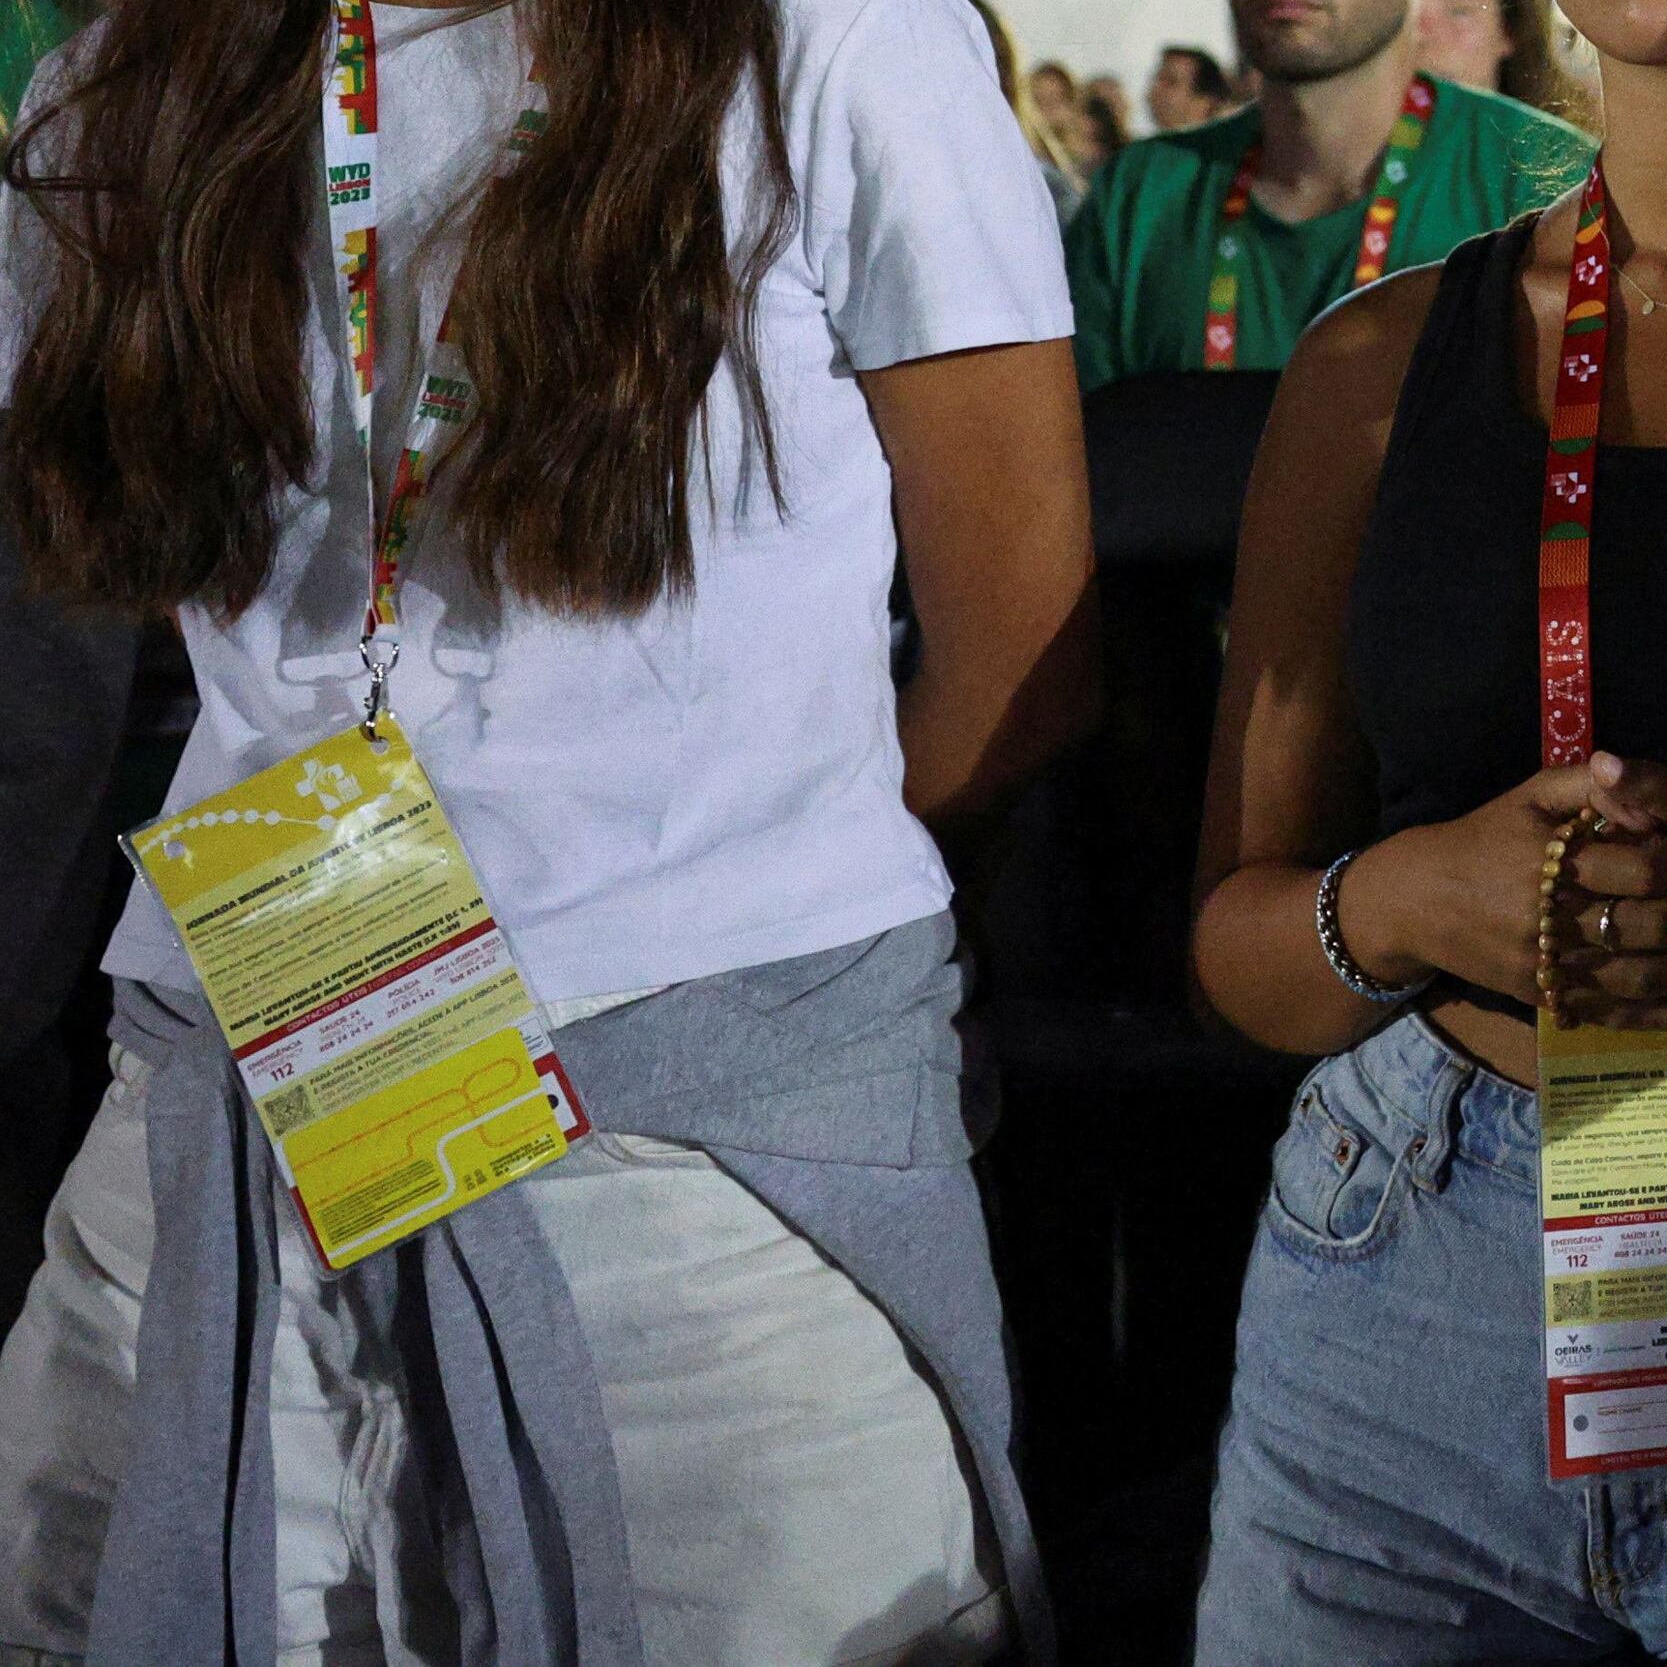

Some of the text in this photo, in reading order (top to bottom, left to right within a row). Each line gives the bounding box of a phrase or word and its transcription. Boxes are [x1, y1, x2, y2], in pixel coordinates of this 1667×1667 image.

[328, 162, 370, 183] WYD
[330, 187, 370, 206] 2023
[269, 1061, 296, 1083] 112
[1593, 1212, 1646, 1225] CONTACTOS
[1565, 1253, 1588, 1268] 112
[1554, 1344, 1592, 1356] OEIRAS
